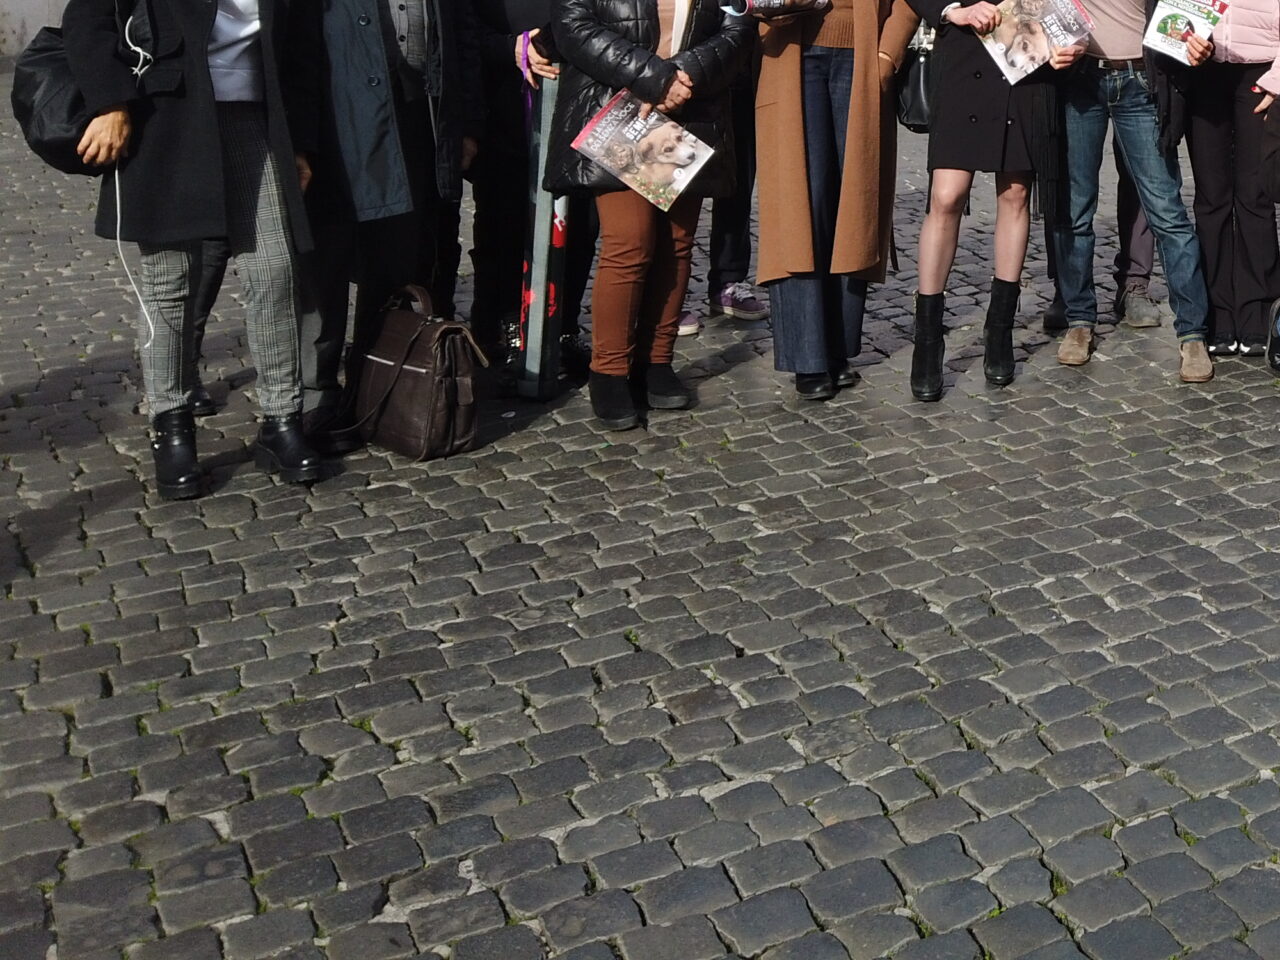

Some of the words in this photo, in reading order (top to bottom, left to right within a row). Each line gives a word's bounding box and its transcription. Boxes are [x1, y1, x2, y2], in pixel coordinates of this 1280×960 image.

[1043, 14, 1068, 46] SEMPRE
[1063, 11, 1079, 31] VOCE
[598, 108, 618, 128] VOCE
[615, 101, 634, 121] VOCE
